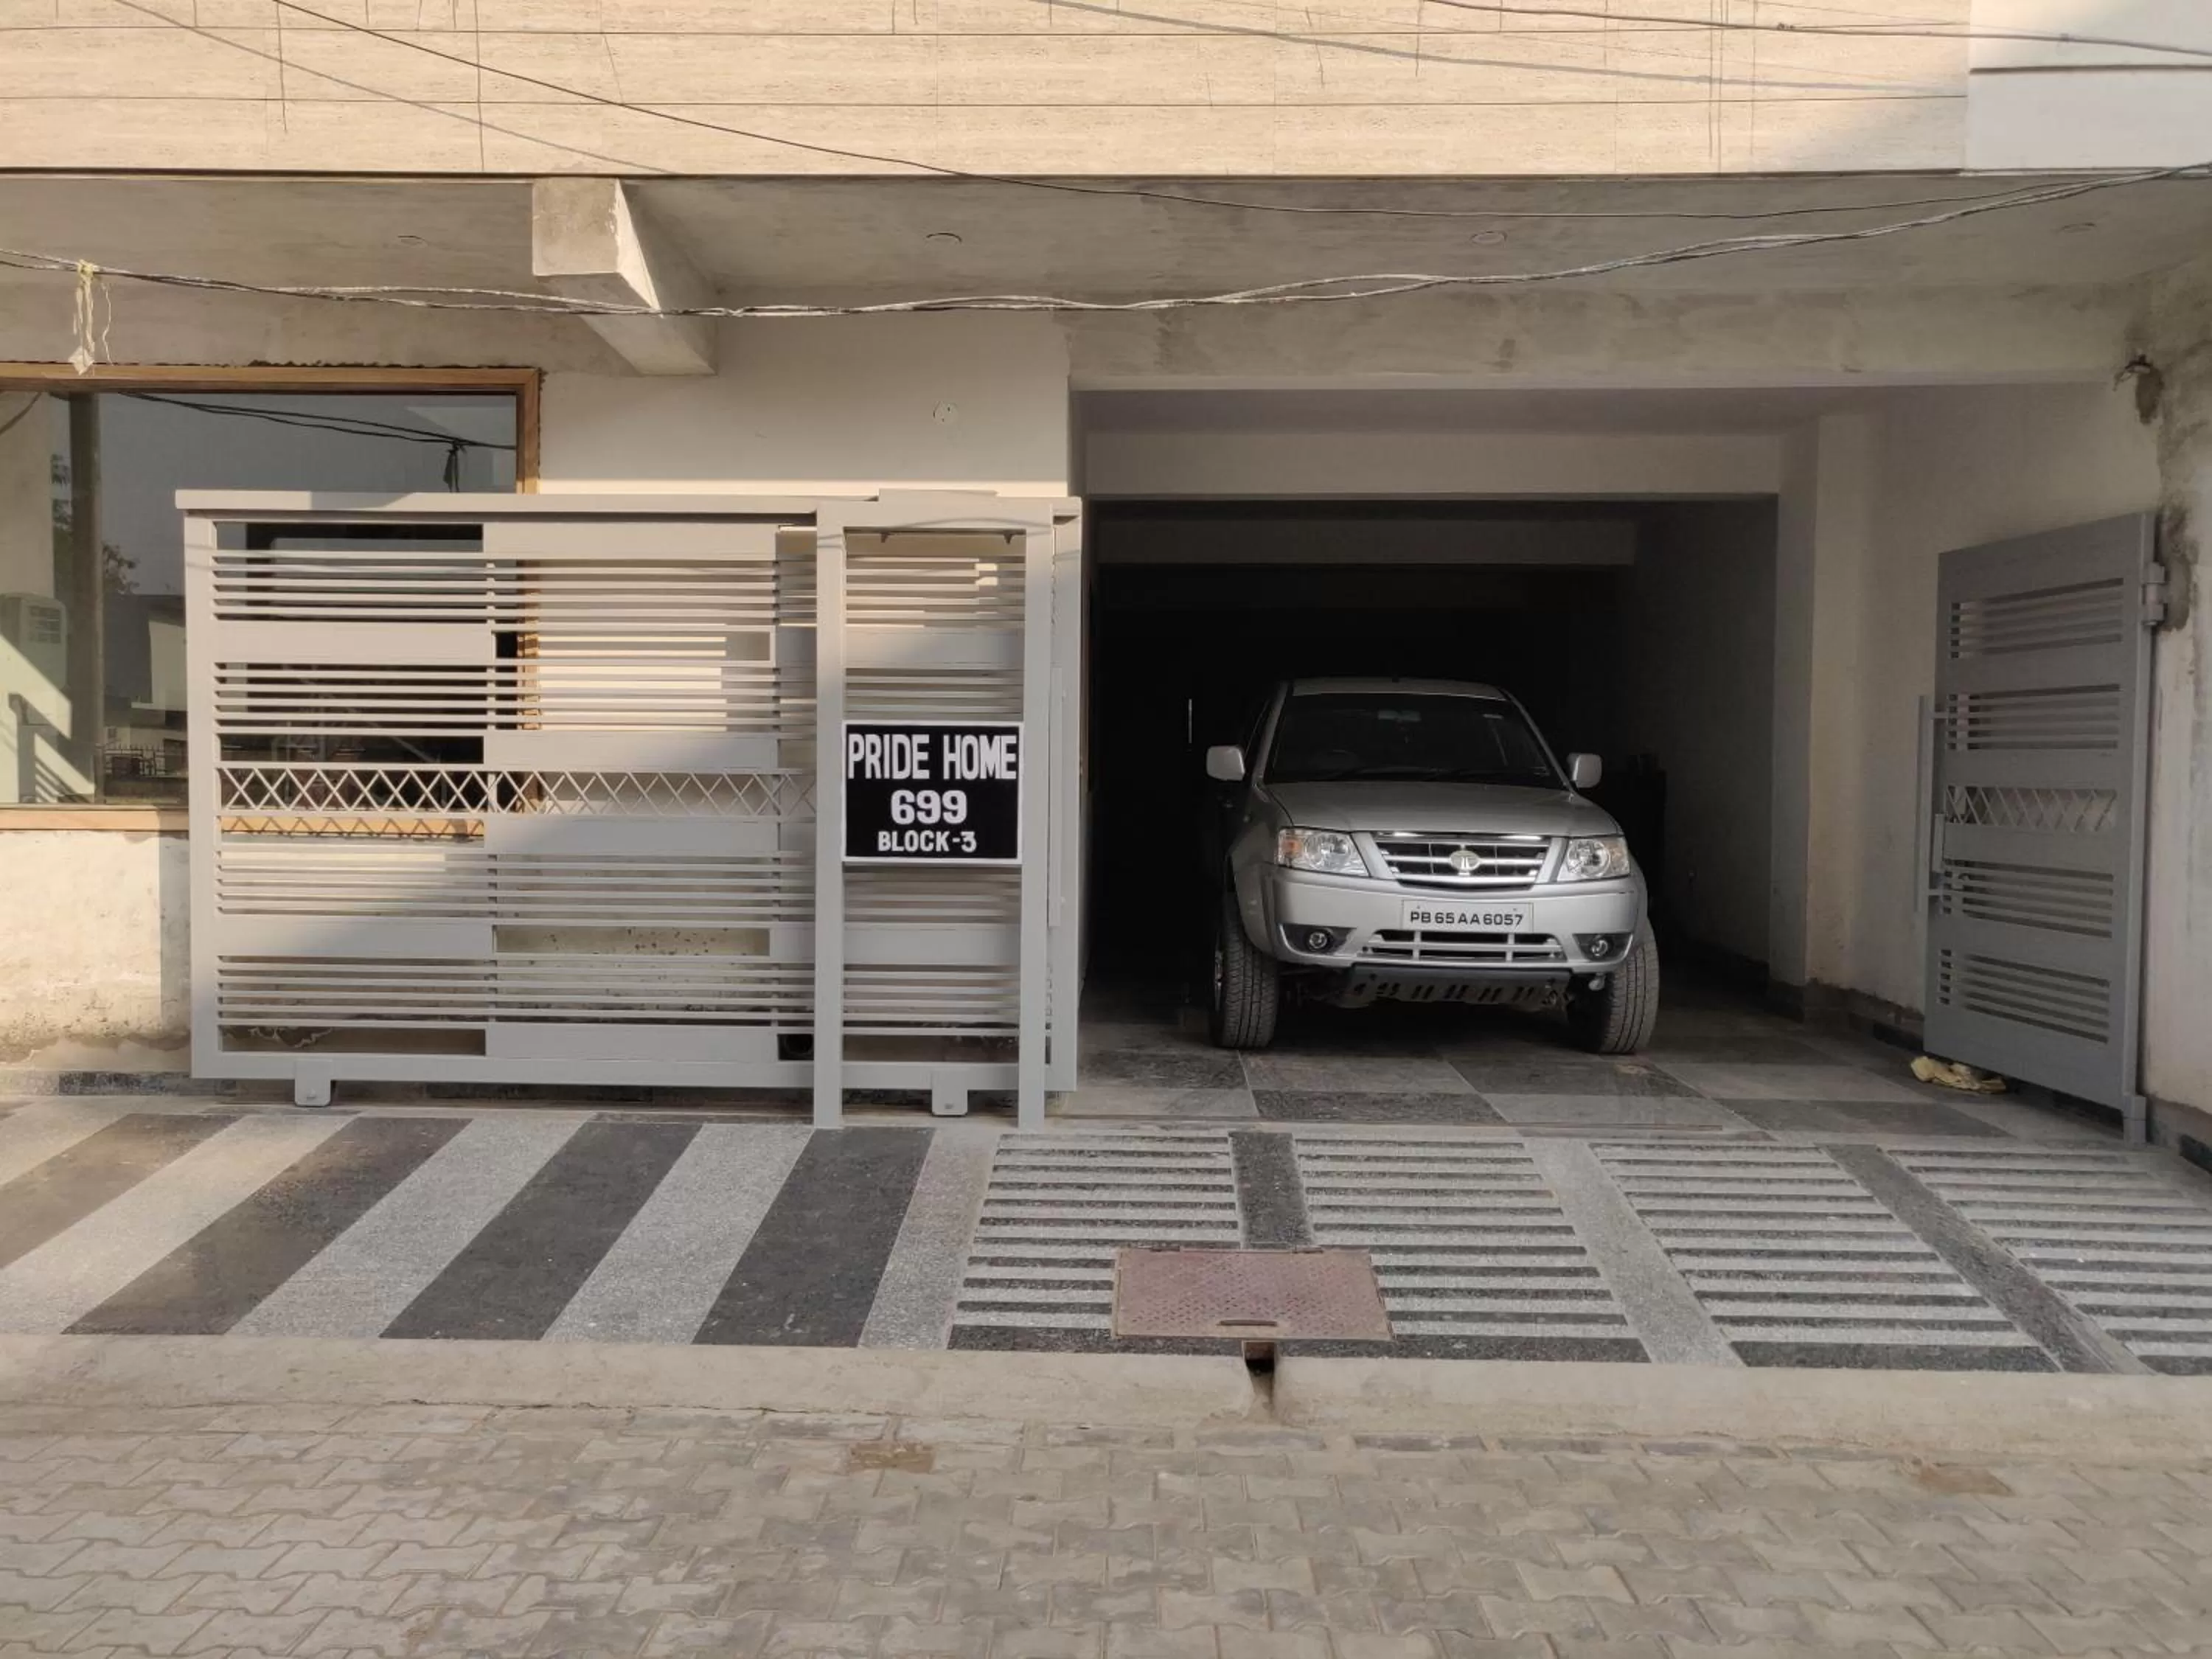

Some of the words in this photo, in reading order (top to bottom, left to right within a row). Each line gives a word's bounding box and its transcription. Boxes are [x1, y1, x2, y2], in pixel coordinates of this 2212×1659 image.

[847, 733, 931, 780] PRIDE
[942, 734, 1017, 781] HOME
[891, 789, 967, 825] 699
[877, 829, 977, 853] BLOCK-3
